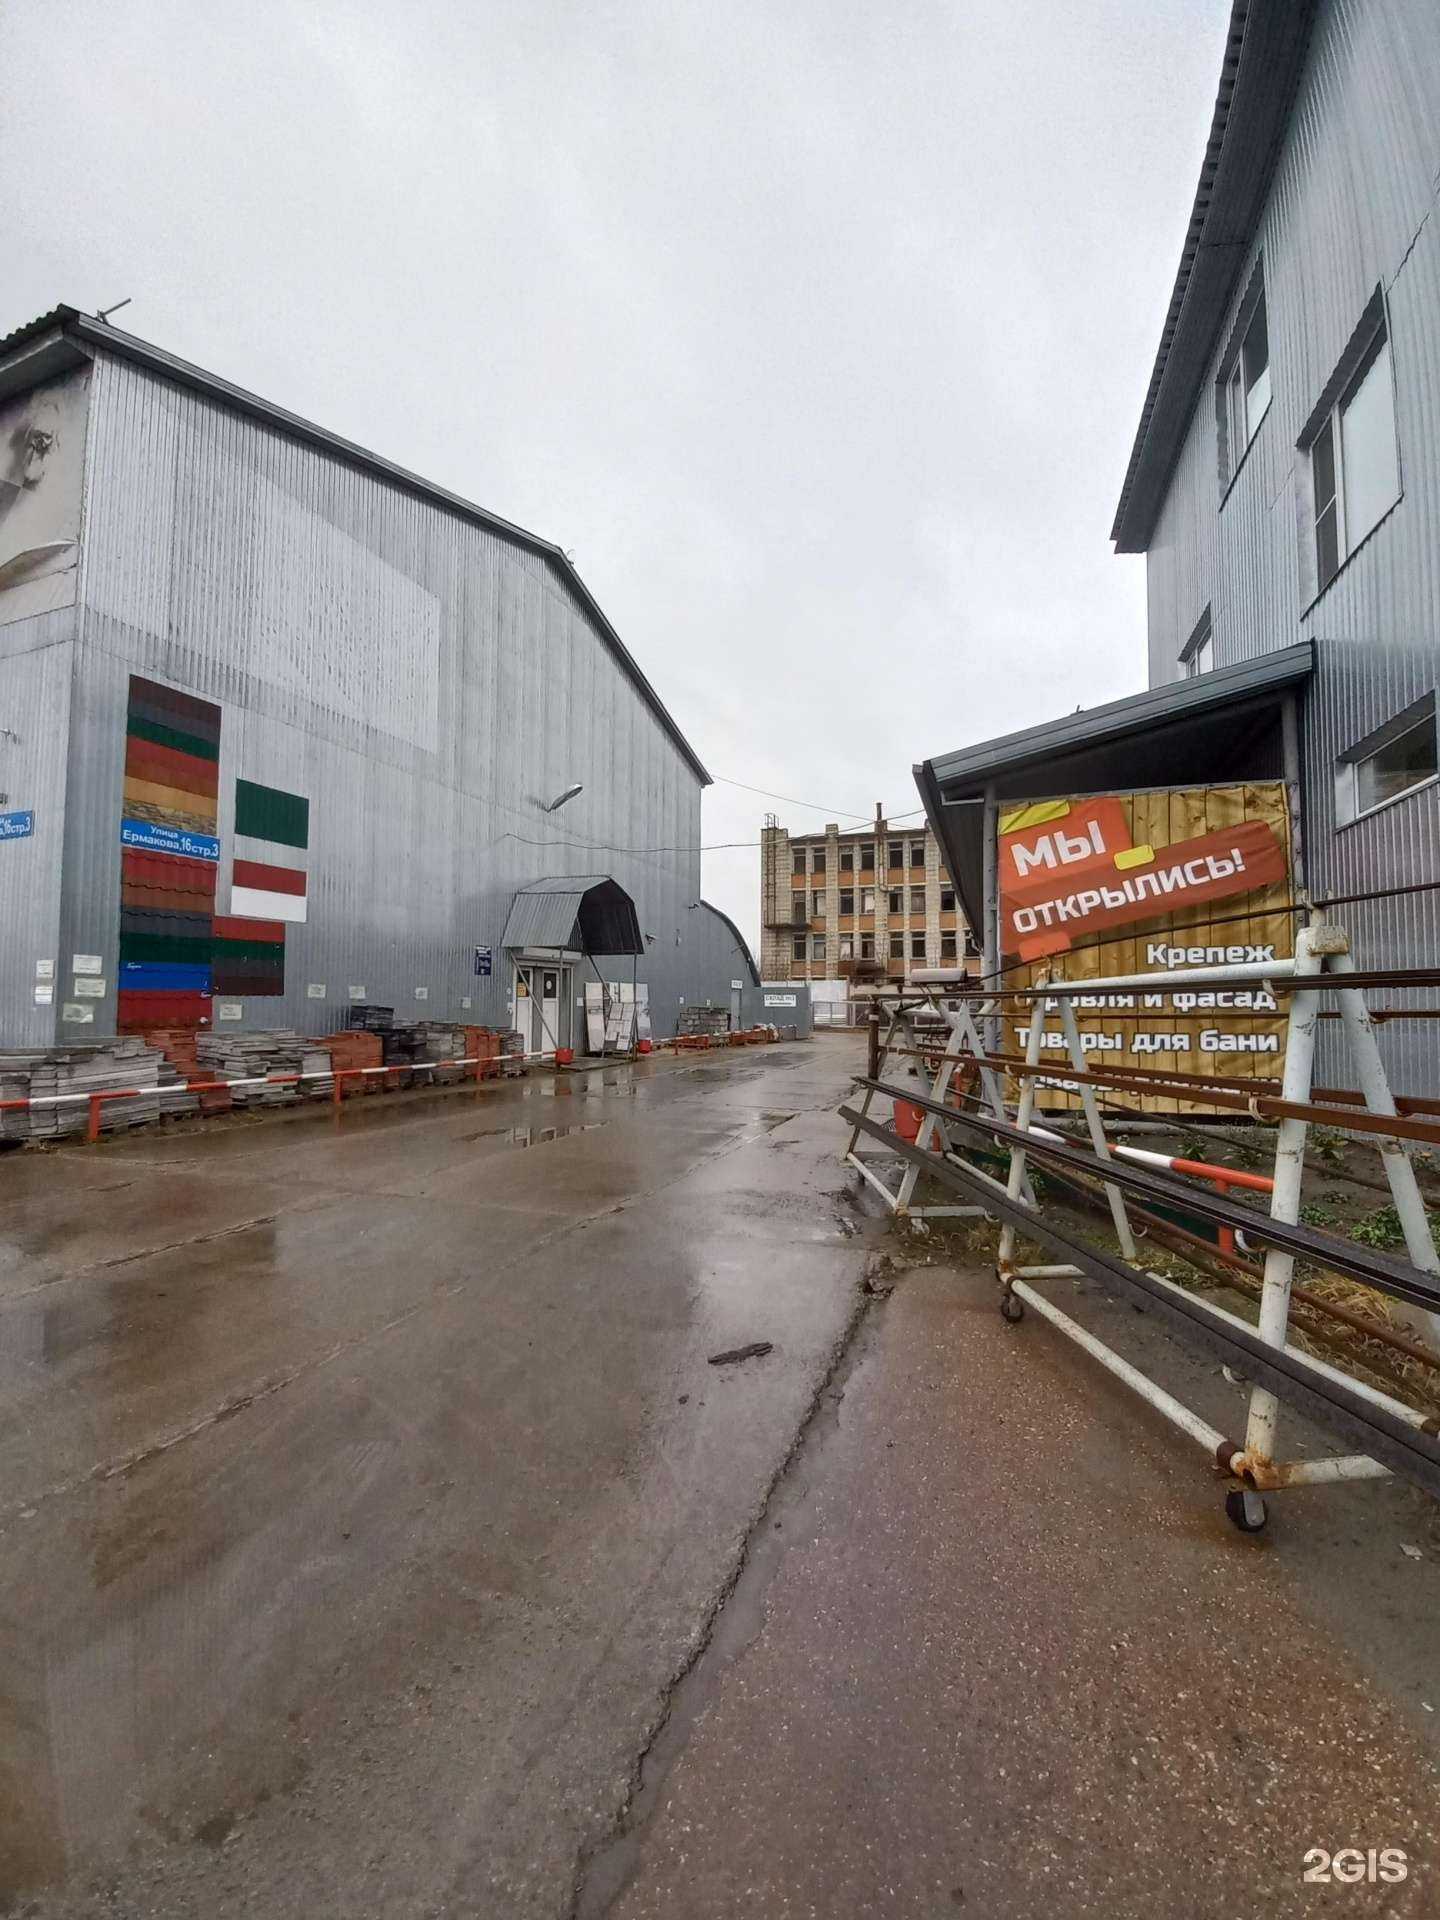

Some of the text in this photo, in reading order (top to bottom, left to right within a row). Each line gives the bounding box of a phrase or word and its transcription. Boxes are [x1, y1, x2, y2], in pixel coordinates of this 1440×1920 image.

[150, 826, 178, 839] Улица
[1010, 820, 1107, 877] МЫ
[1012, 848, 1248, 934] ОТКРЫЛИСЬ!
[1146, 943, 1275, 968] Крепеж
[1172, 990, 1278, 1012] фасад
[1131, 1033, 1190, 1054] для
[1199, 1029, 1279, 1052] бани
